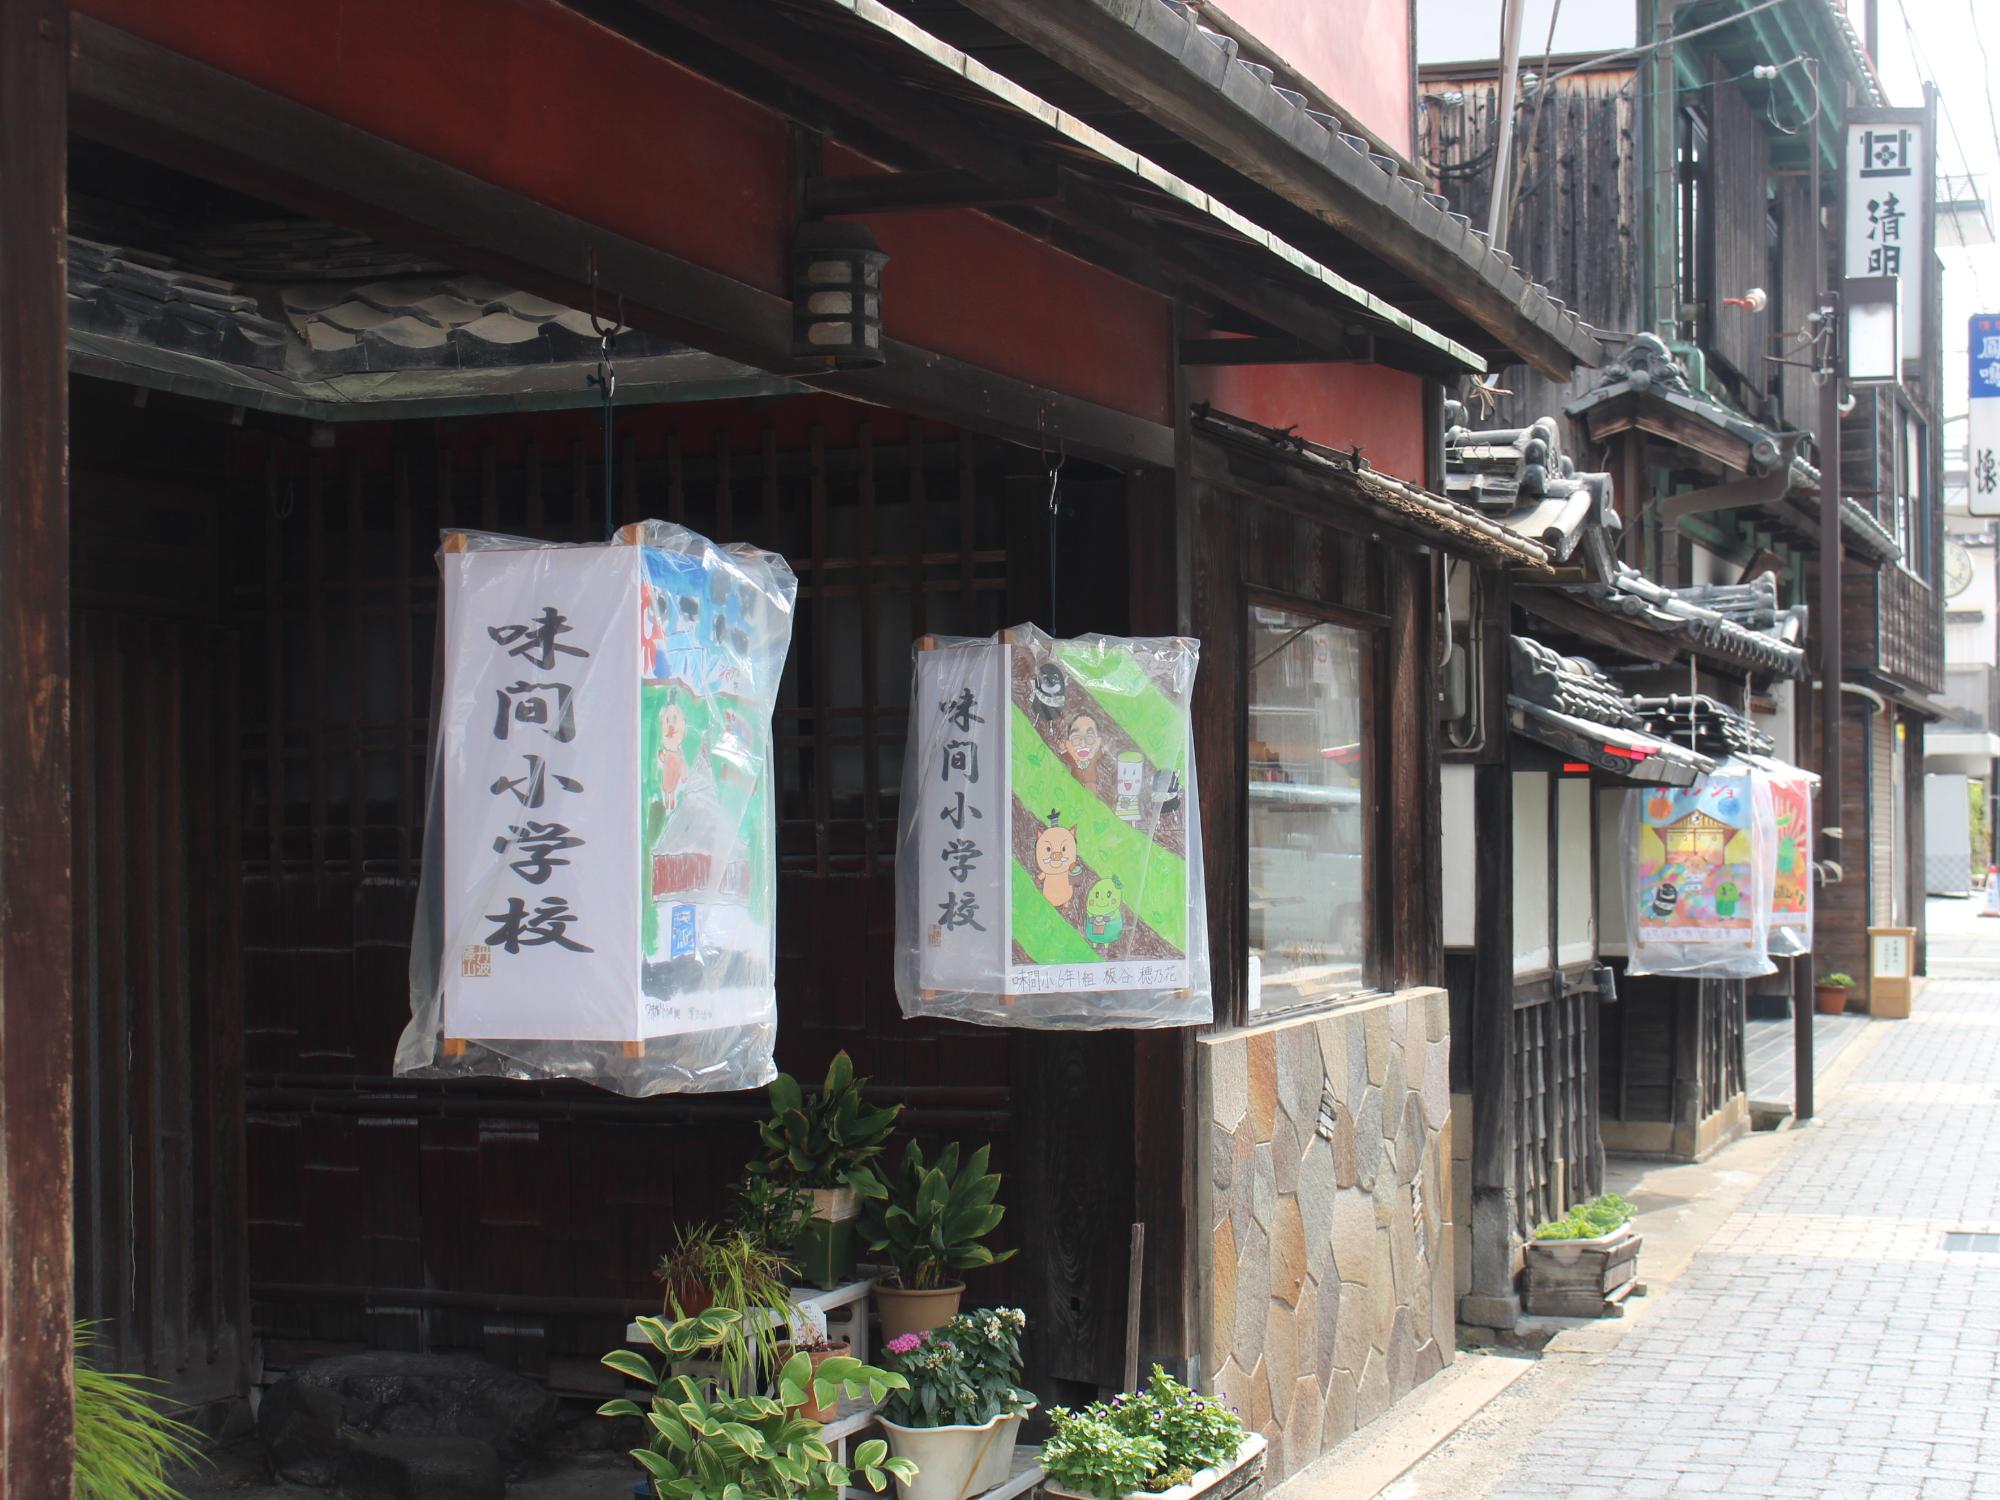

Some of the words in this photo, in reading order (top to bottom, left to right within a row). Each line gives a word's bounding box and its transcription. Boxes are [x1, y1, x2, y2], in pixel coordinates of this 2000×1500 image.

[1866, 192, 1905, 276] 清明
[485, 606, 594, 955] 味間小学校
[938, 688, 986, 933] 味間小学校
